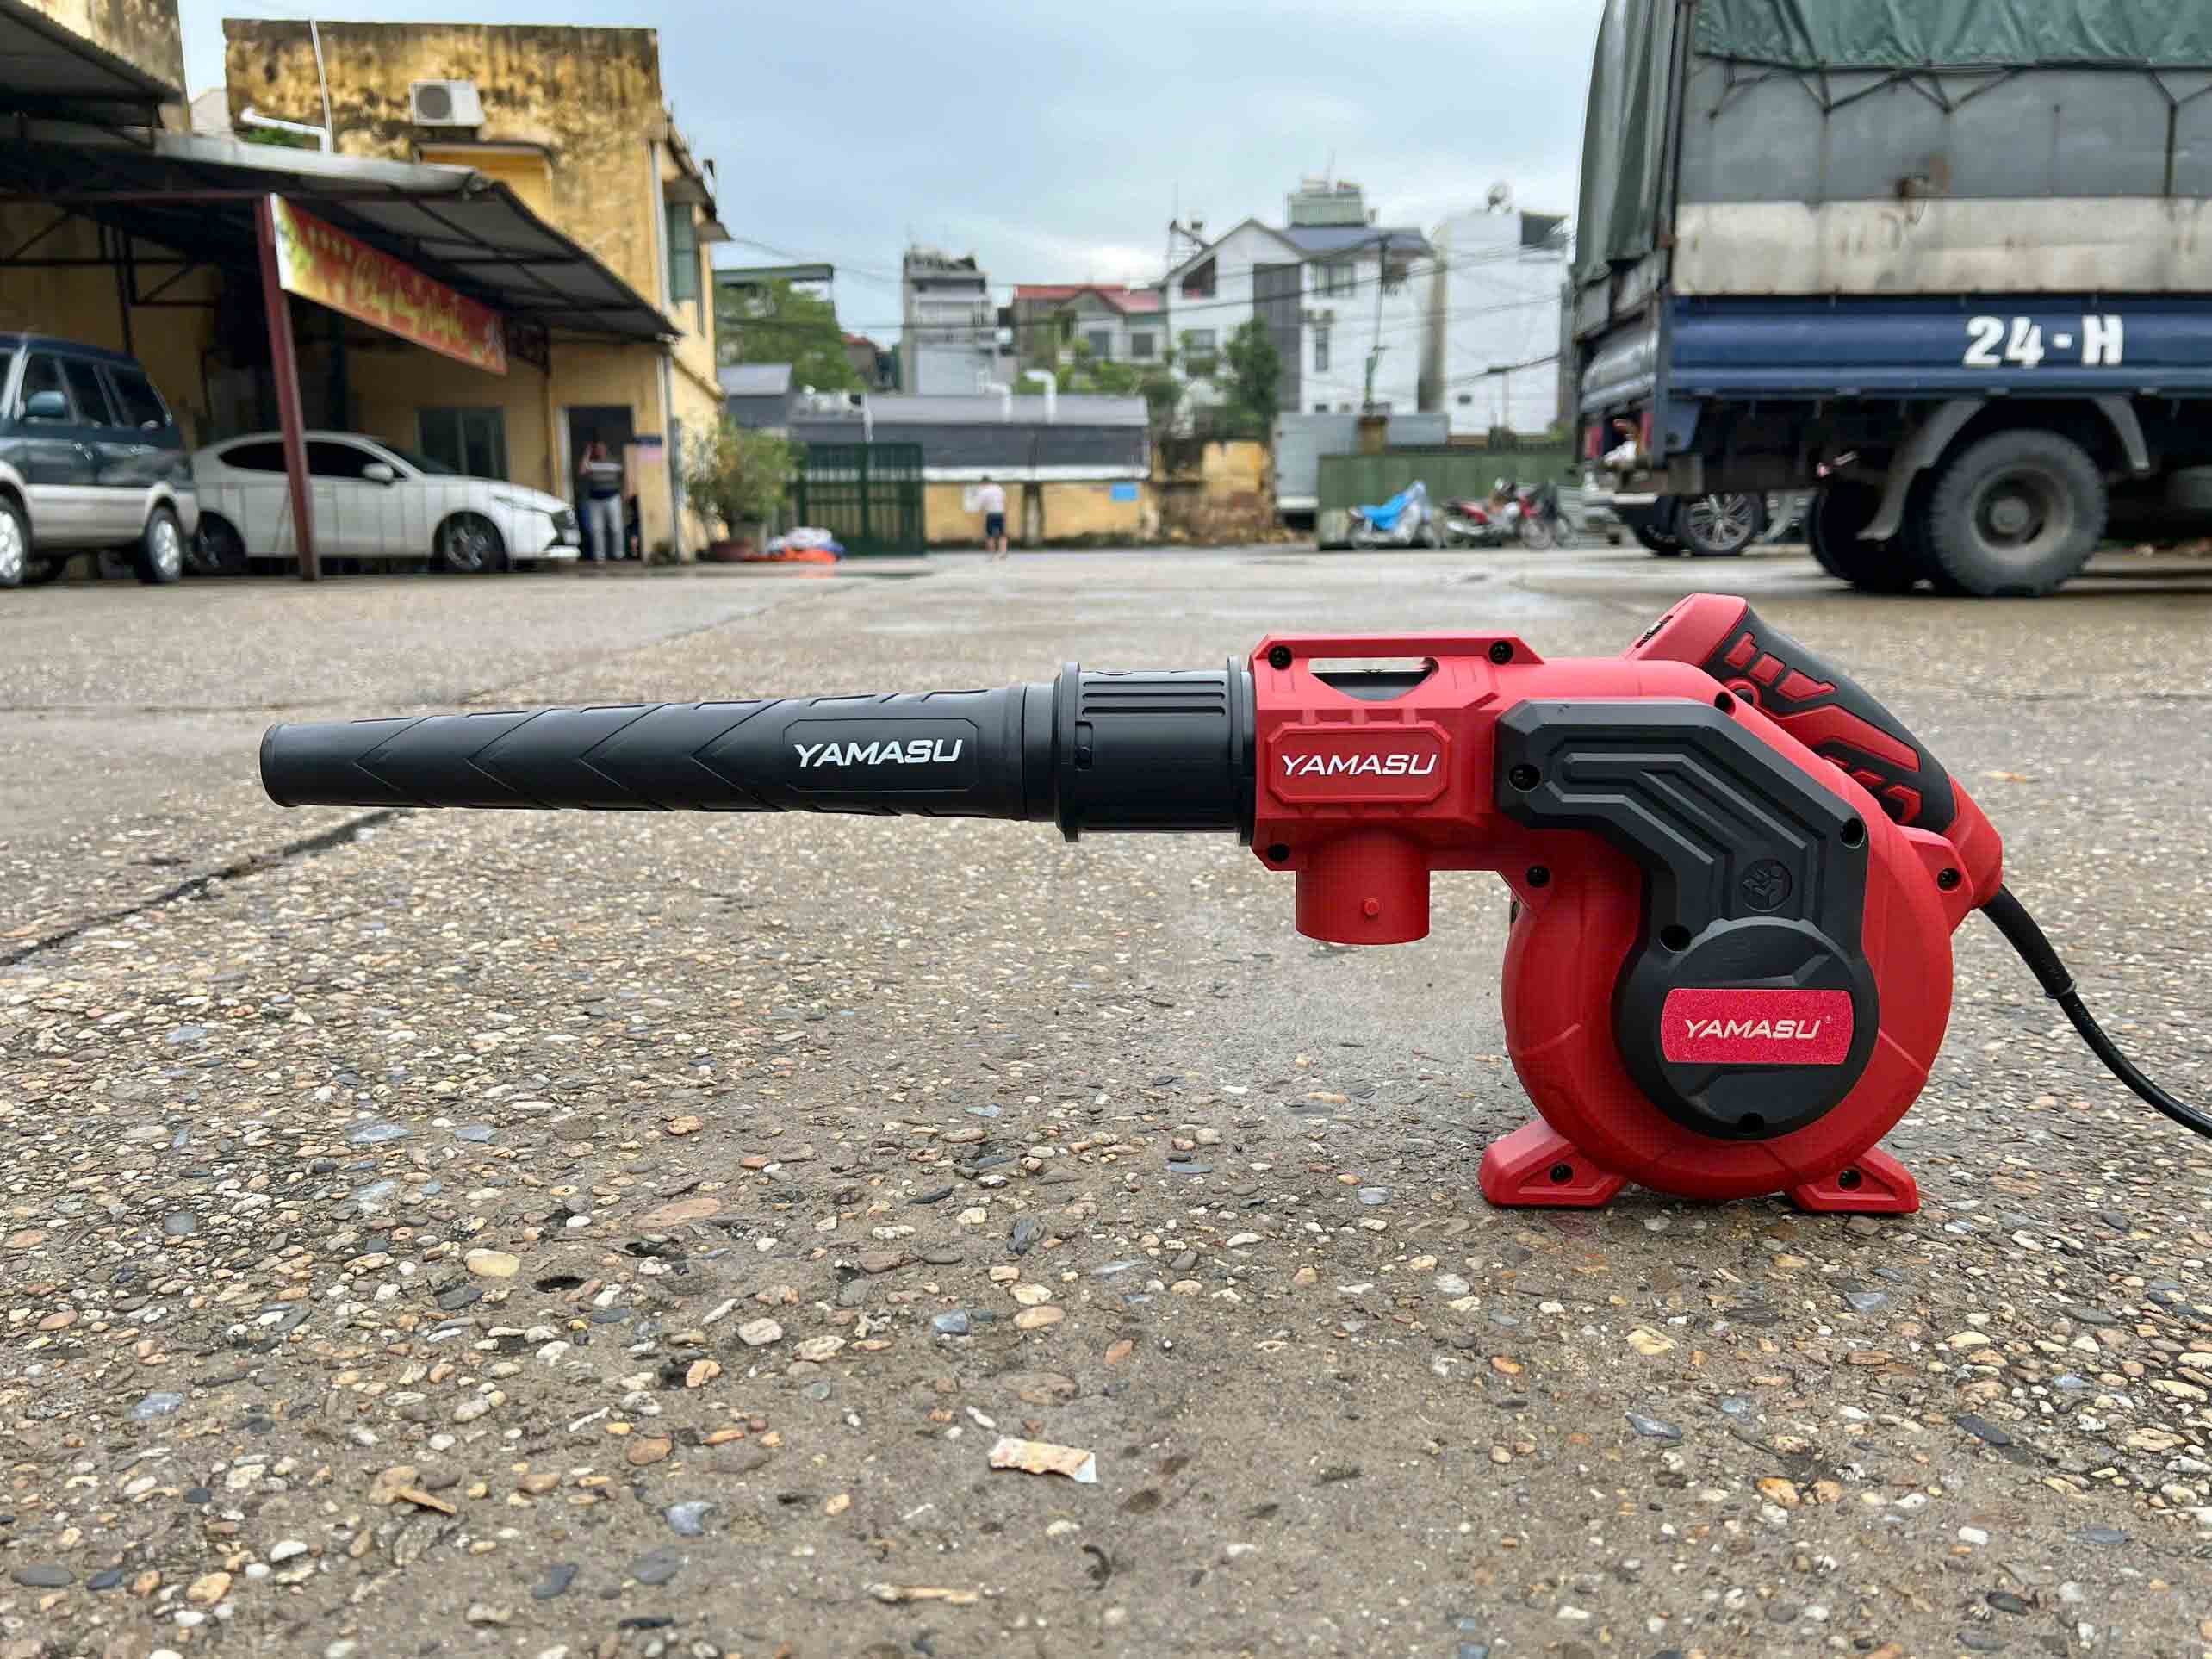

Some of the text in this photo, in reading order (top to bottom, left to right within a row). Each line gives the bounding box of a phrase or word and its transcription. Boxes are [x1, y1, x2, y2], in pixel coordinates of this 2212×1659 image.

[793, 739, 963, 767] YAMASU
[1282, 754, 1437, 775] YAMASU
[1684, 1019, 1821, 1039] YAMASU
